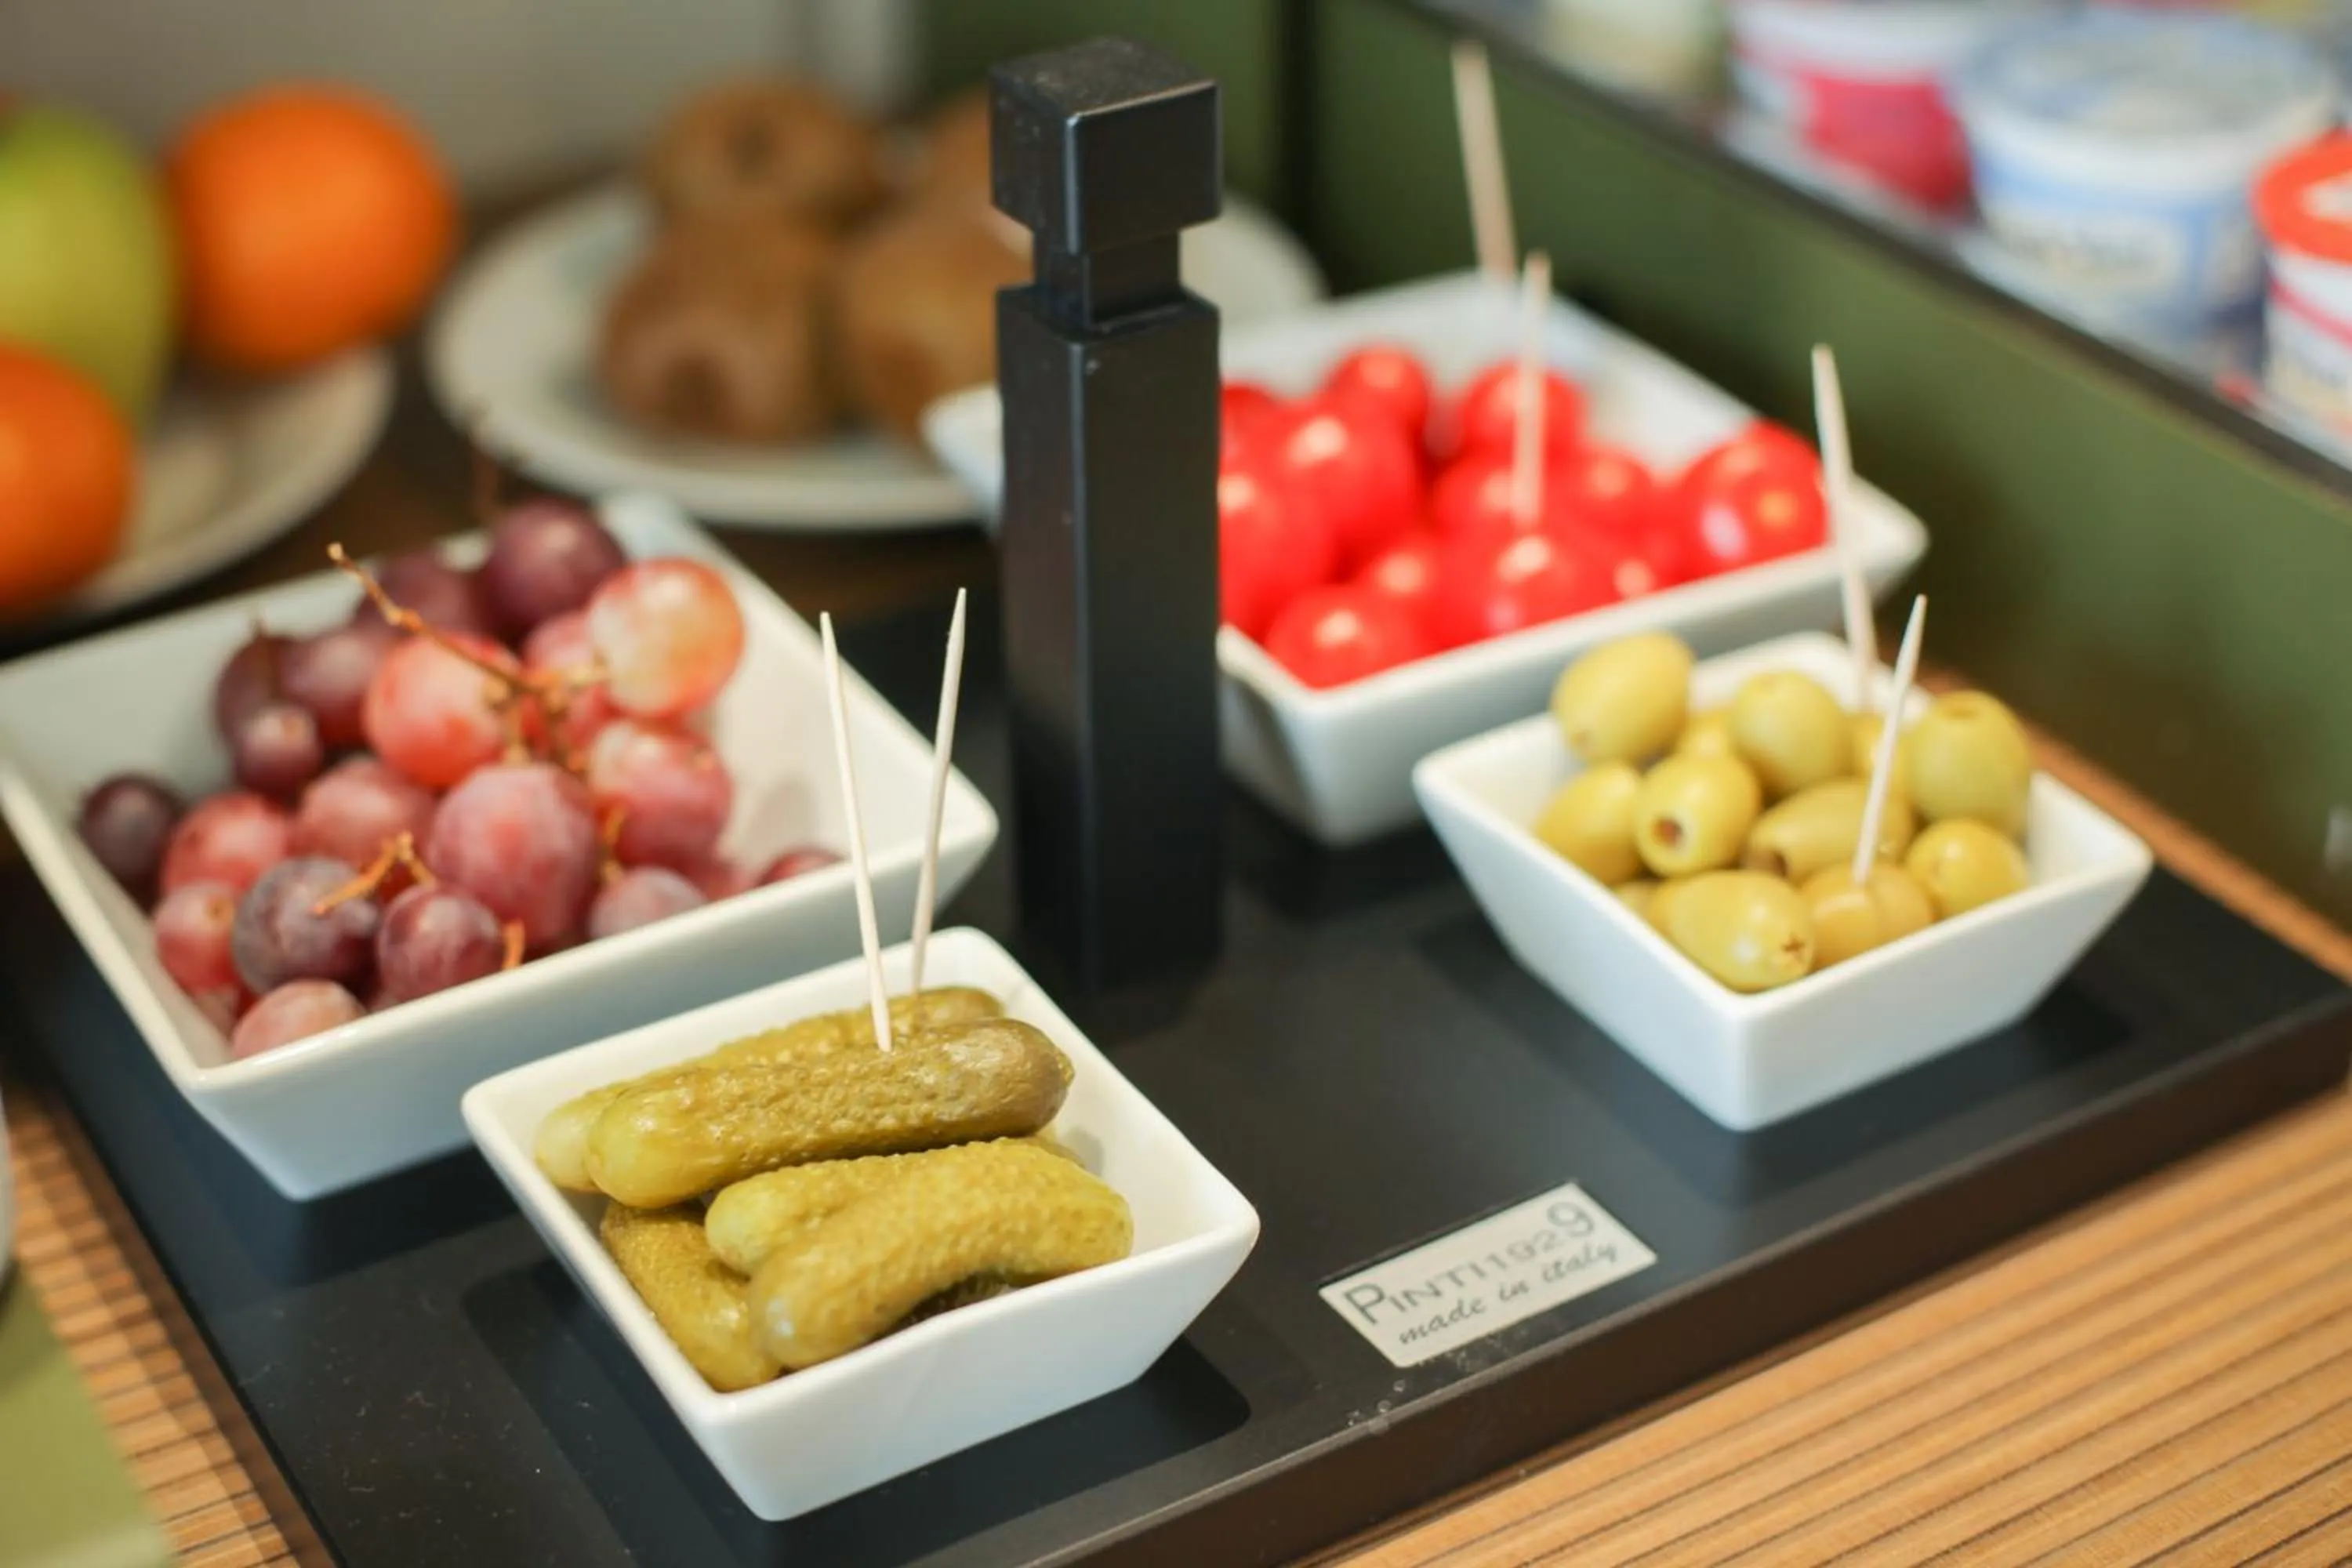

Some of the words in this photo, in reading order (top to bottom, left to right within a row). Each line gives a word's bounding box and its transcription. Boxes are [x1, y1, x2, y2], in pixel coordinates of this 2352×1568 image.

[1399, 1297, 1487, 1345] made
[1498, 1280, 1530, 1303] in
[1541, 1241, 1618, 1284] italy
